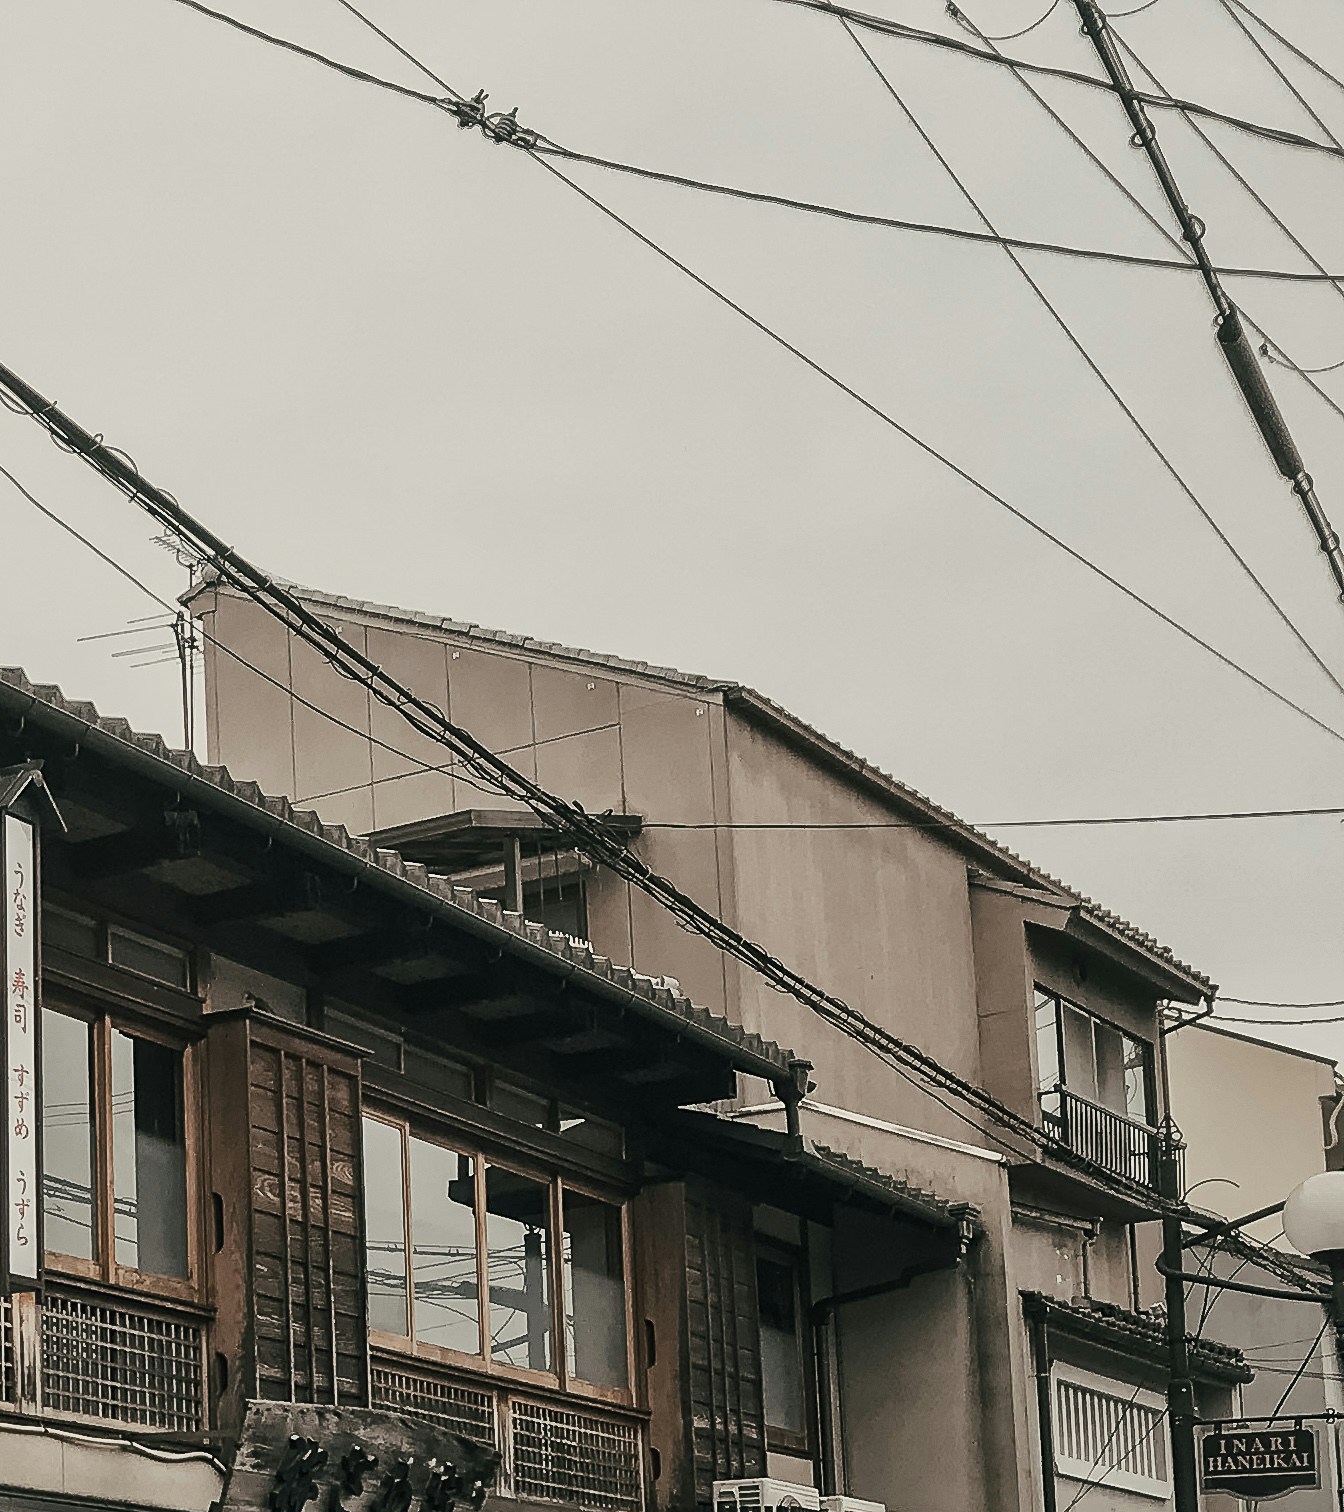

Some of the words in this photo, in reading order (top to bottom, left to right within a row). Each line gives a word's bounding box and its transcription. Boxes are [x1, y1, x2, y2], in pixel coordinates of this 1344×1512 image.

[13, 862, 27, 937] うなぎ
[12, 967, 29, 1034] 寿司
[12, 1064, 30, 1140] すずめ
[14, 1169, 31, 1247] うずら
[1207, 1452, 1309, 1471] HANEIKAI
[1219, 1436, 1297, 1454] INARI
